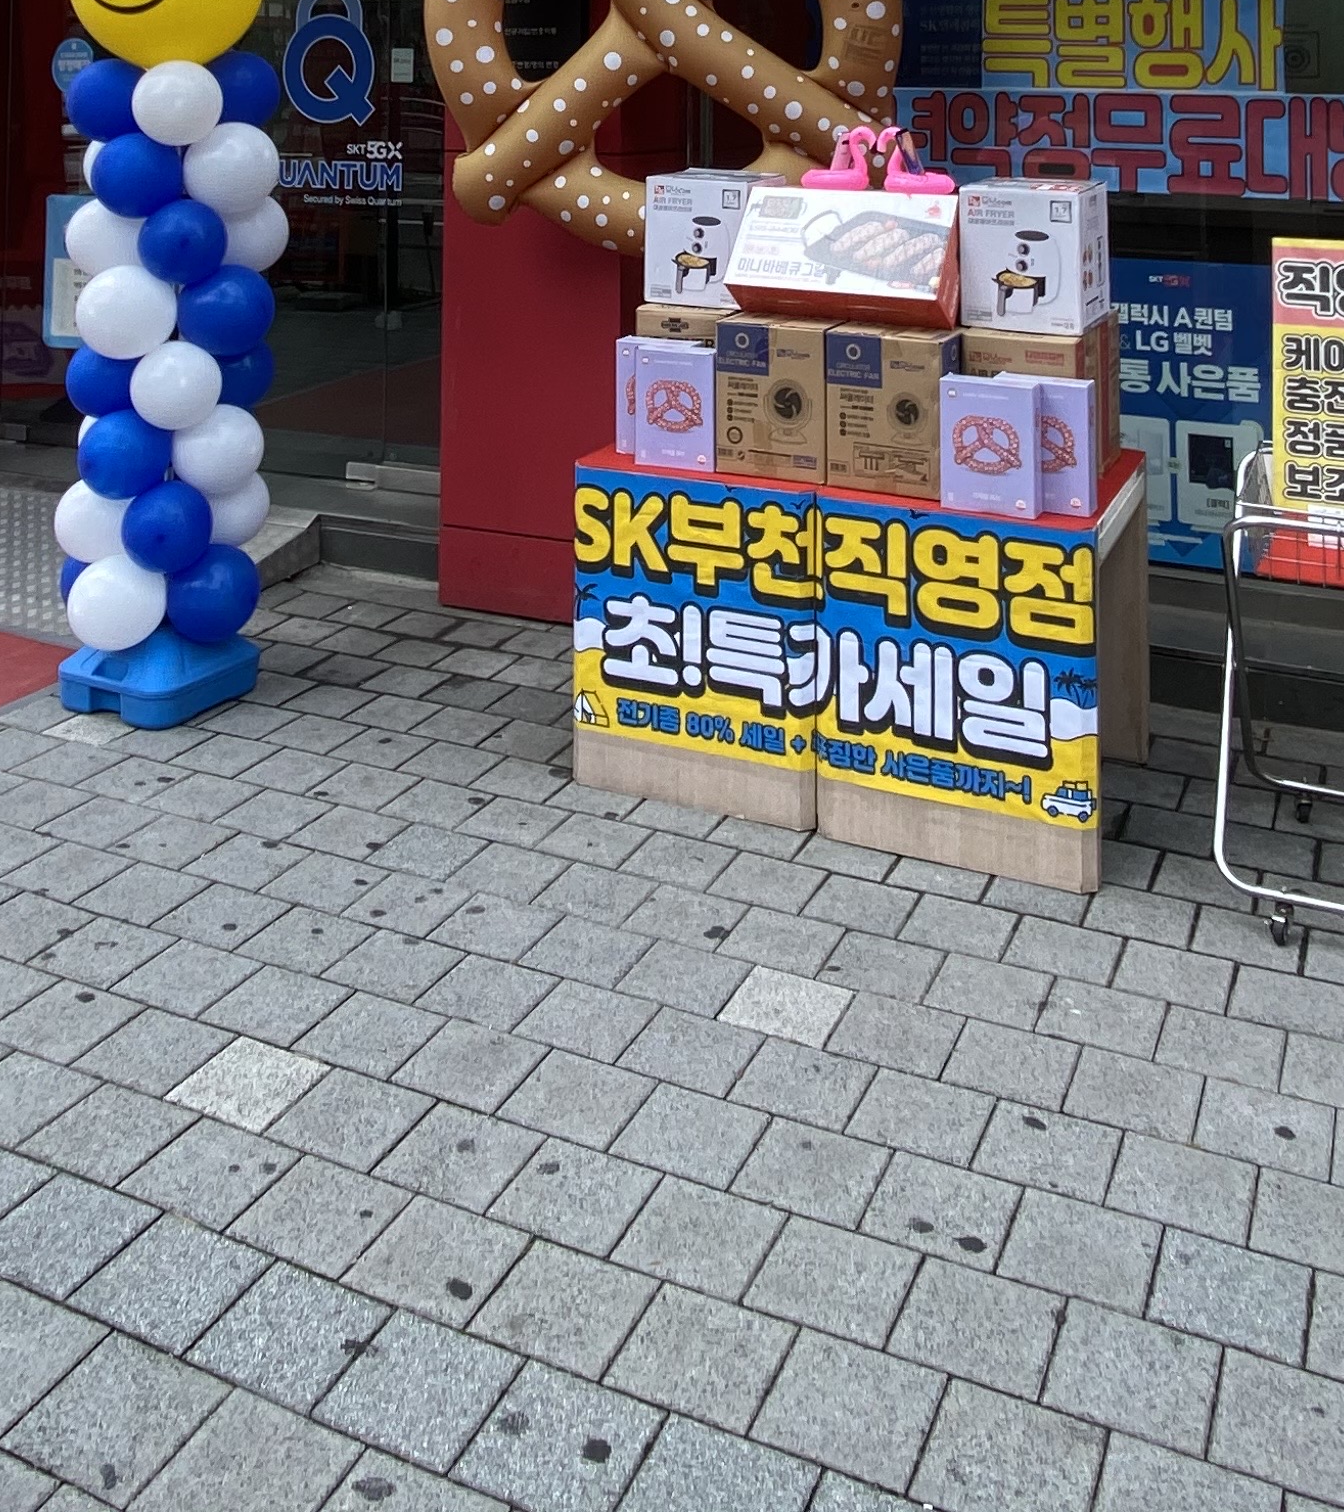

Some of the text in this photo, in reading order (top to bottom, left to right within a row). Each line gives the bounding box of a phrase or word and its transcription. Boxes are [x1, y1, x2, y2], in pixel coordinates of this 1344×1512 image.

[278, 159, 403, 192] UANTUM
[737, 257, 762, 274] 미니
[1135, 330, 1169, 353] LG
[1173, 330, 1214, 357] 벨벳
[1156, 360, 1262, 404] 사은품
[574, 486, 1095, 646] SK부천직영점
[603, 595, 1052, 761] 초!특가세일
[616, 697, 682, 735] 전기종
[685, 712, 737, 745] 80%
[740, 723, 787, 758] 세일
